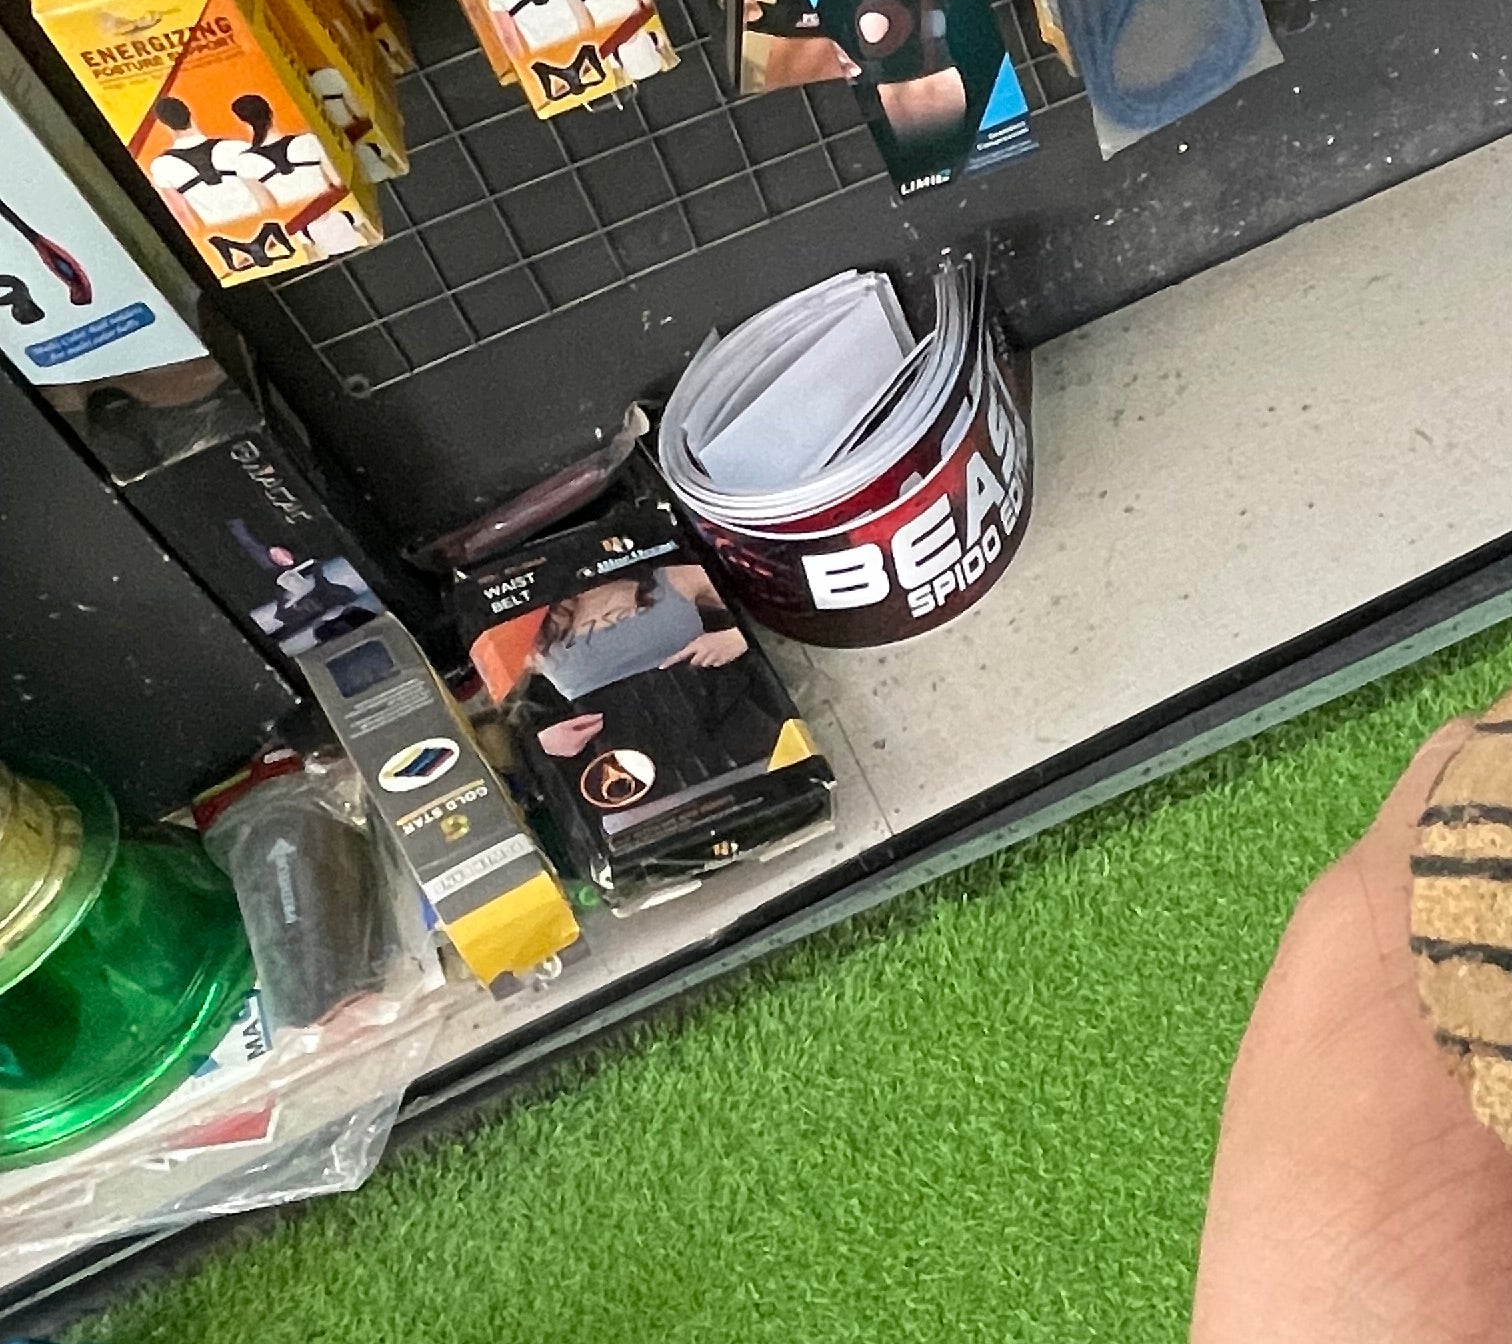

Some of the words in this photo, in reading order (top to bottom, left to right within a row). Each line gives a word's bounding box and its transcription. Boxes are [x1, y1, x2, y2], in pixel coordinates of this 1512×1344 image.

[80, 15, 234, 68] ENERGIZING
[92, 54, 165, 80] POSTURE
[482, 571, 537, 601] WAIST
[907, 523, 1002, 619] SPIDO
[490, 589, 532, 615] BELT
[446, 784, 490, 818] GOLD
[401, 804, 448, 837] STAR
